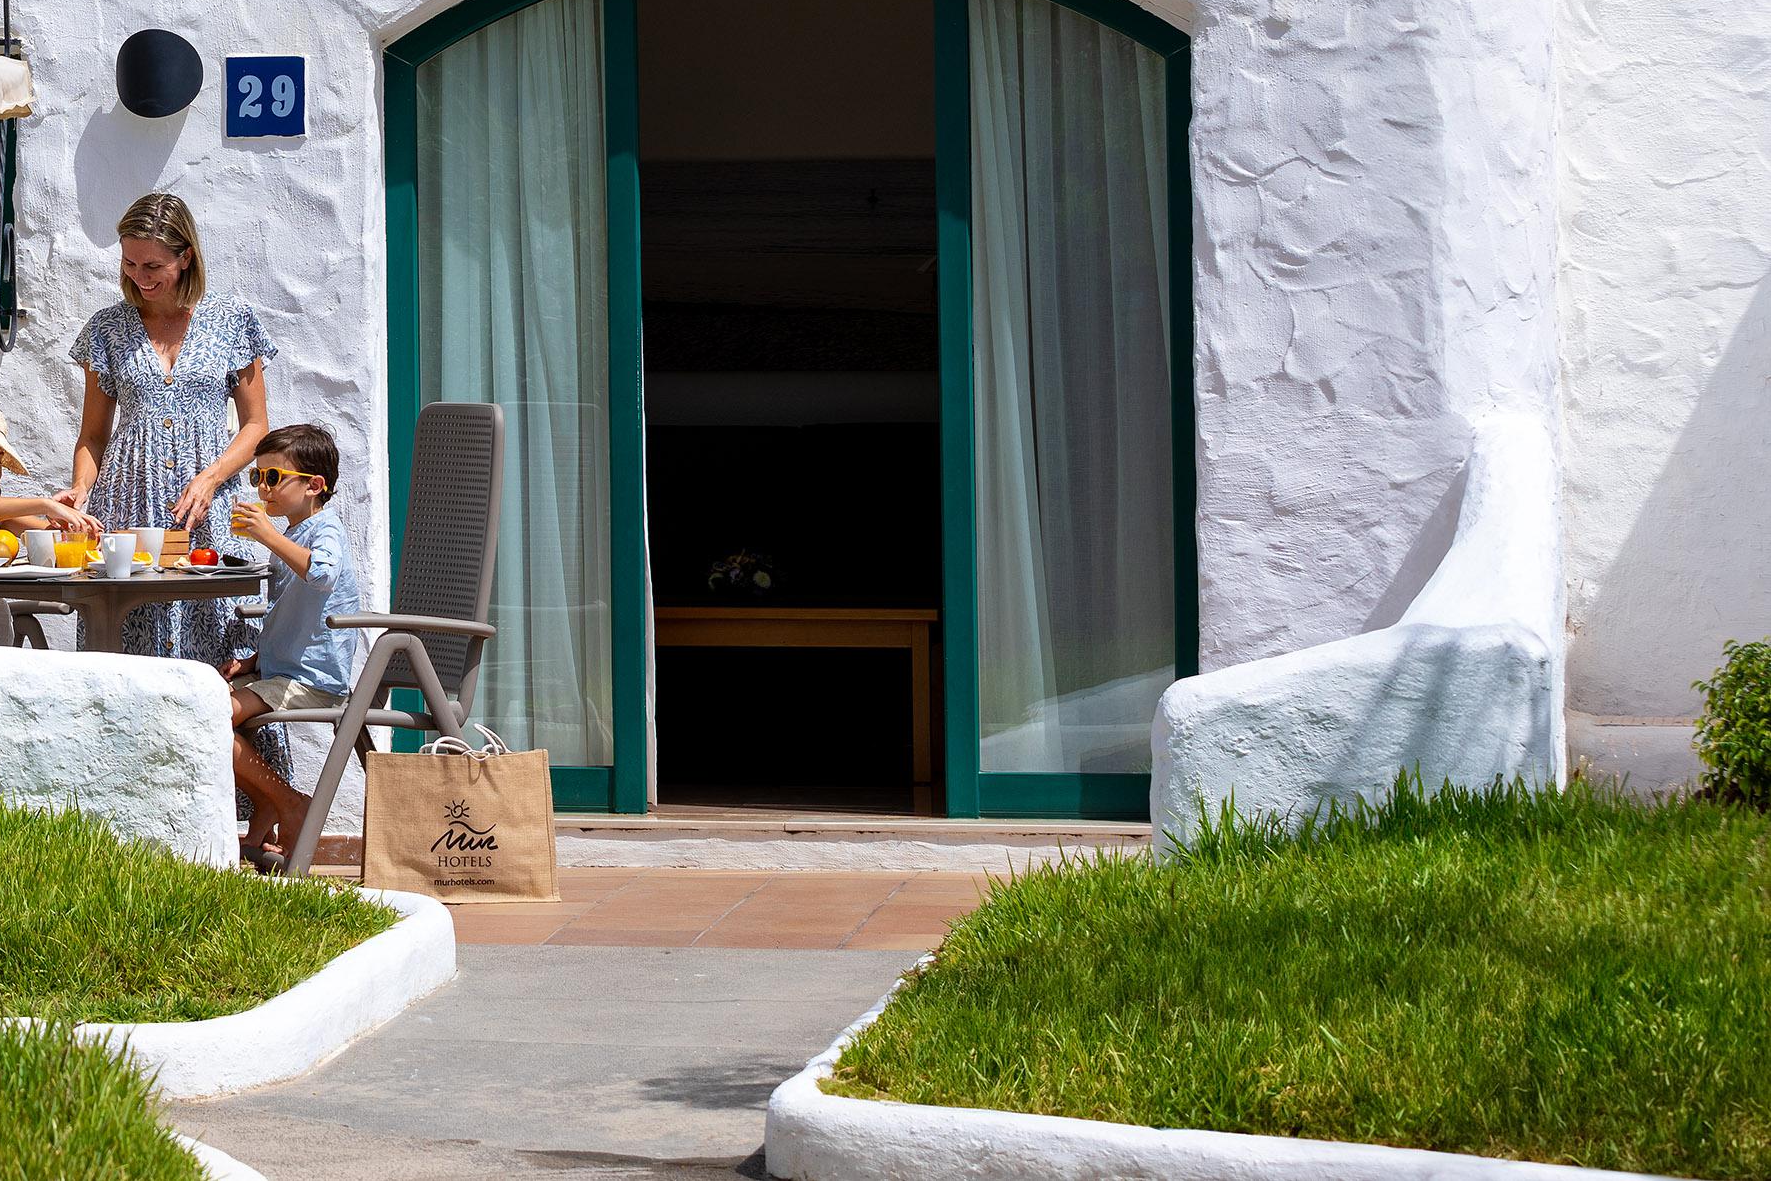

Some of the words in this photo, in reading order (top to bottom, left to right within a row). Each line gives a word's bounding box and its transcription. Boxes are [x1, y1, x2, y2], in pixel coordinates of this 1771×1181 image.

[238, 74, 296, 118] 29
[438, 855, 492, 868] HOTELS
[434, 877, 495, 886] murhotels.com
